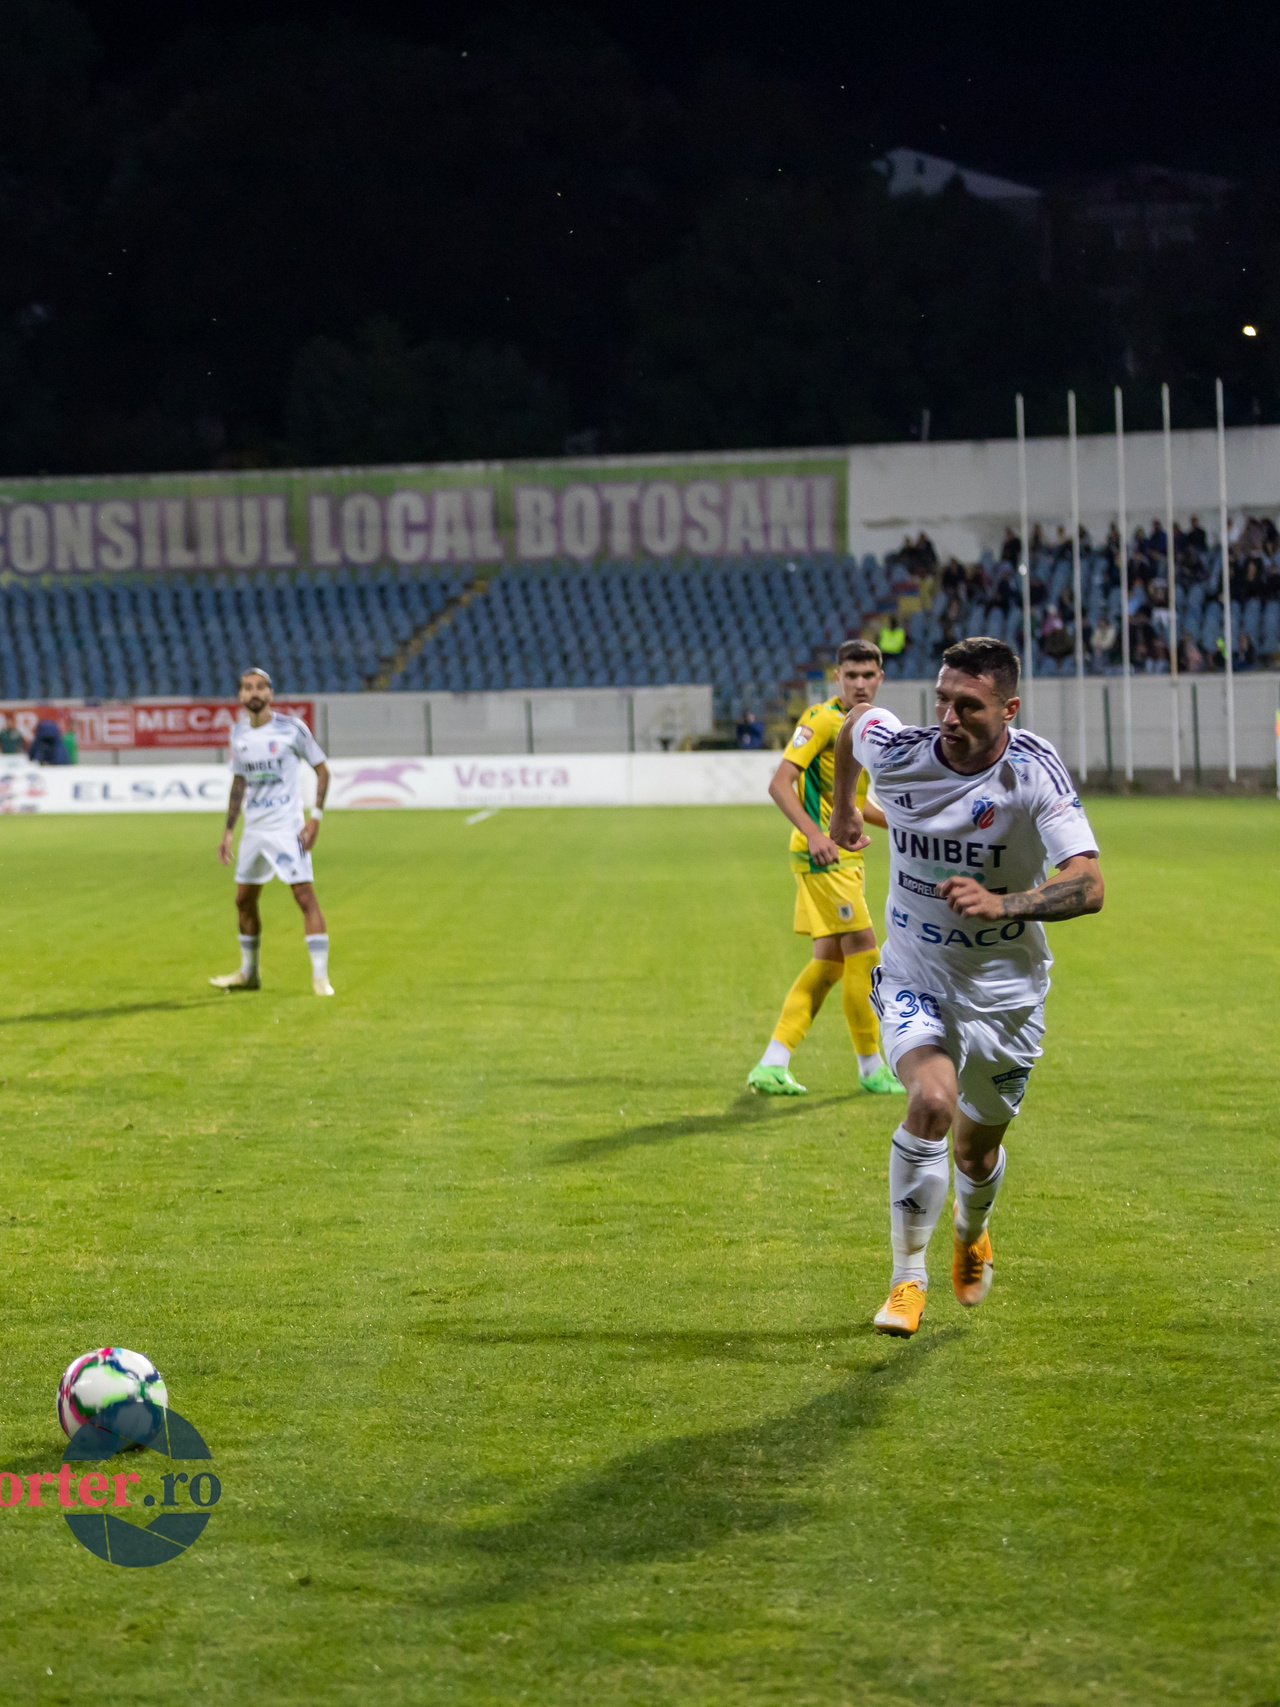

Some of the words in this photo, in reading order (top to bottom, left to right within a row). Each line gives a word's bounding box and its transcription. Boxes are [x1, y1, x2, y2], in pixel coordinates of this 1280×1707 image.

[308, 487, 505, 566] LOCAL
[514, 474, 839, 562] BOTOSANI
[72, 778, 226, 802] ELSAC
[453, 763, 570, 788] Vestra
[892, 827, 1007, 868] UNIBET
[902, 911, 1026, 949] SACO
[895, 989, 942, 1020] 30
